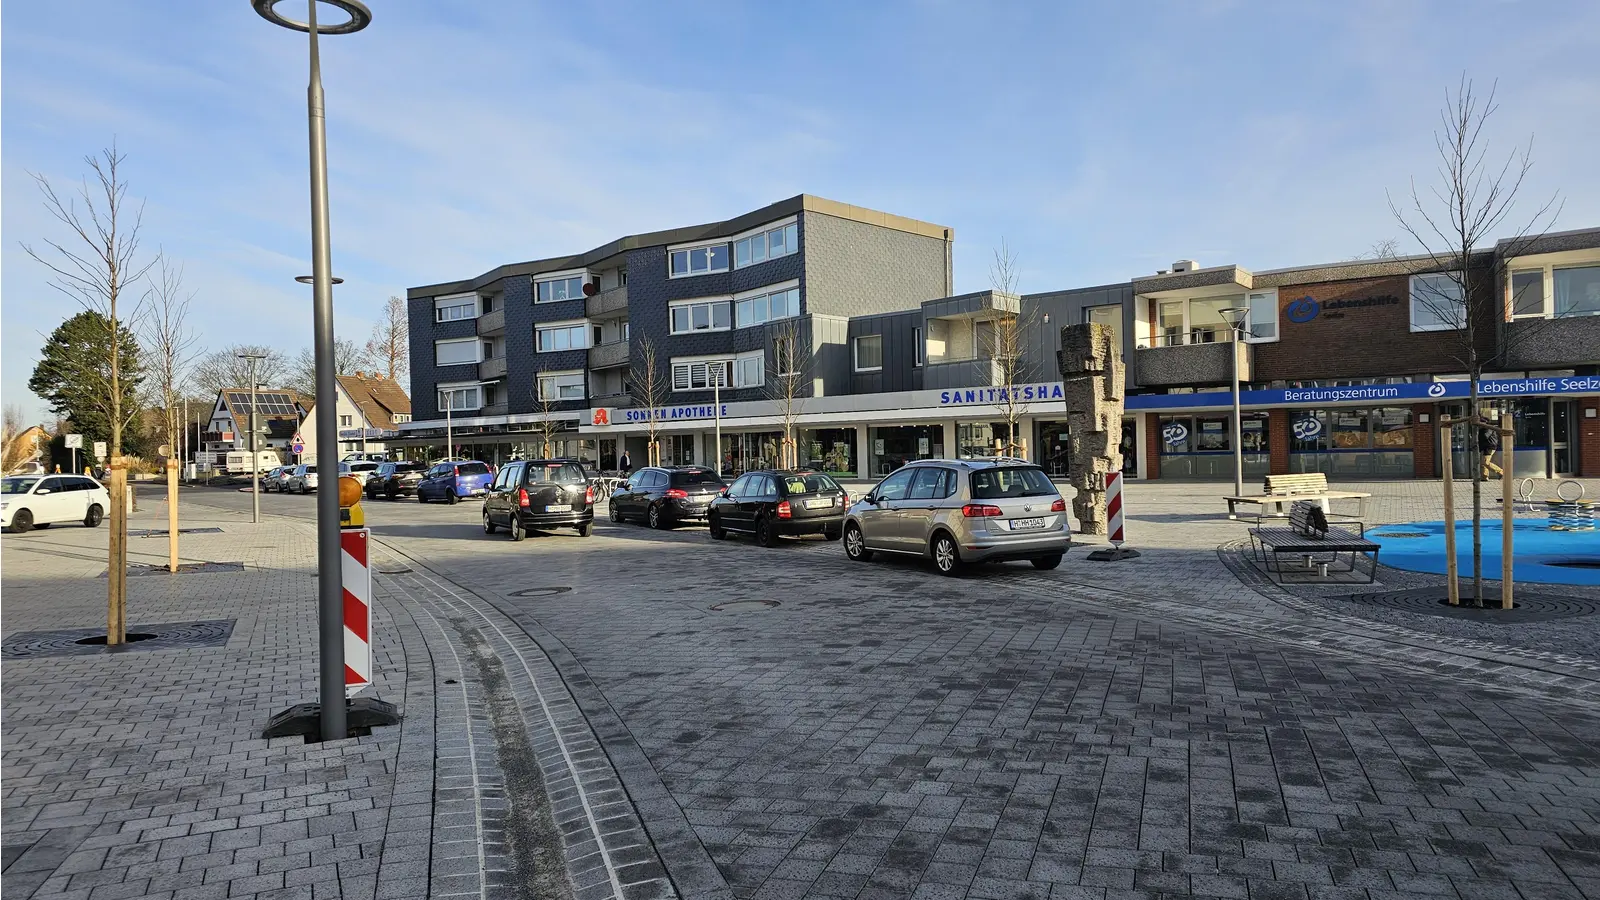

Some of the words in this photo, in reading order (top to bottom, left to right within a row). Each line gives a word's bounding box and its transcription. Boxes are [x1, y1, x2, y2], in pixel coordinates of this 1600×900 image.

[1322, 295, 1399, 310] Lebenshilfe
[1284, 387, 1398, 401] Beratungszentrum
[1477, 379, 1556, 394] Lebenshilfe
